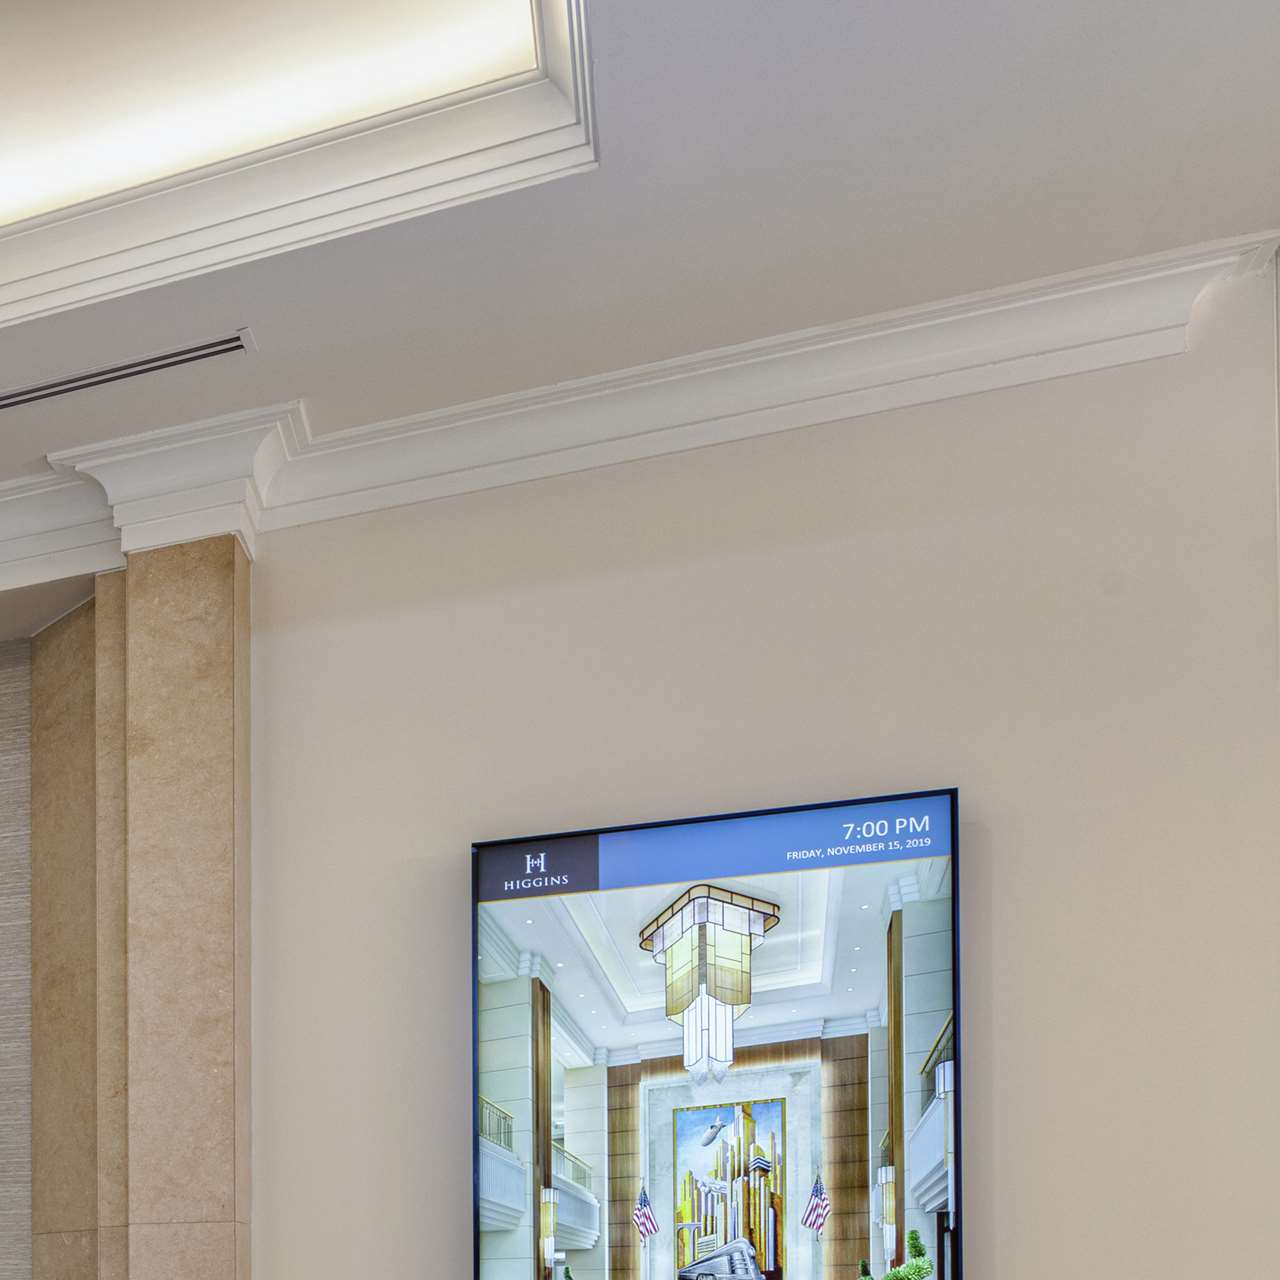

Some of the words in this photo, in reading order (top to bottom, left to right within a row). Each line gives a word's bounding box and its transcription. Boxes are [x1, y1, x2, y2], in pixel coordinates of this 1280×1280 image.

[842, 820, 888, 840] 7:00
[895, 815, 930, 835] PM
[786, 849, 825, 860] FRIDAY,
[828, 842, 885, 857] NOVEMBER
[888, 840, 903, 851] 15,
[906, 837, 931, 848] 2019
[504, 875, 569, 891] HIGGINS
